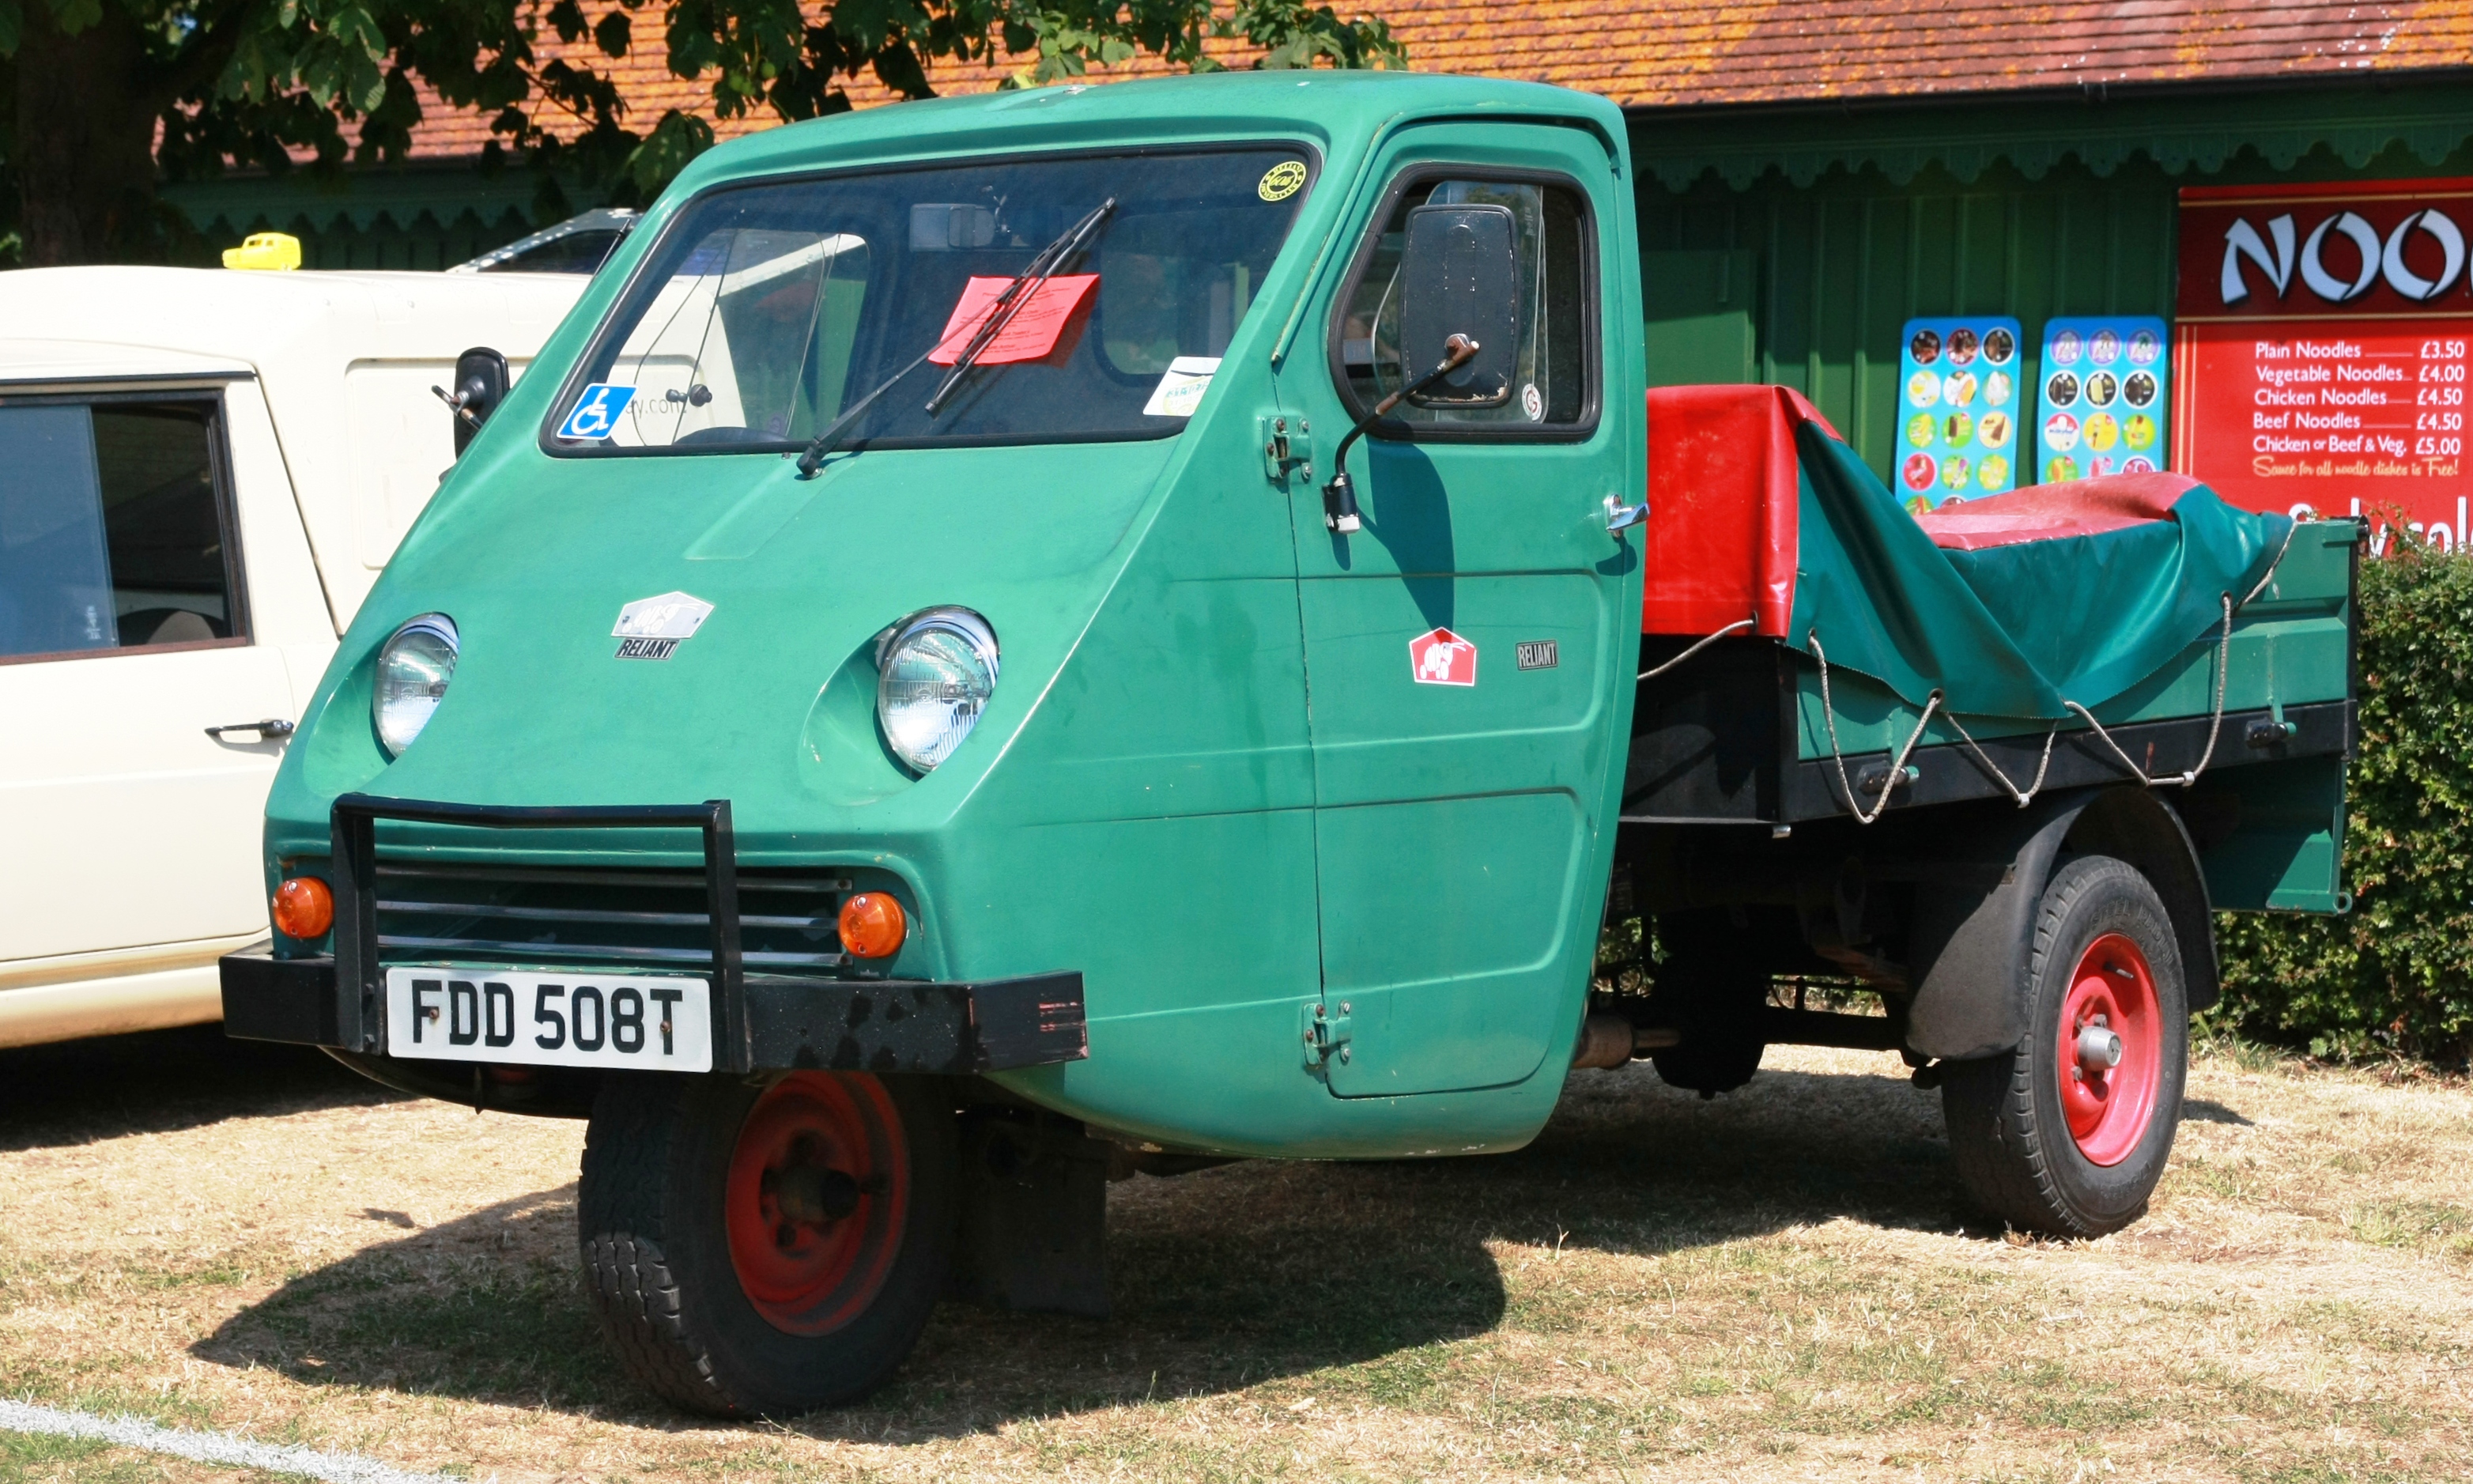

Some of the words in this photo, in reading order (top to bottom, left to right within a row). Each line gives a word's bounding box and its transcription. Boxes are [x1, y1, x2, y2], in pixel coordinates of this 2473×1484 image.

[2220, 208, 2473, 304] NOO
[2256, 342, 2290, 358] Plain
[2296, 341, 2361, 358] Noodles
[2421, 341, 2465, 358] £3.50
[2256, 365, 2331, 387] Vegetable
[2337, 364, 2403, 381] Noodles
[2419, 364, 2465, 382] £4.00
[2254, 388, 2315, 406] Chicken
[2321, 388, 2387, 405] Noodles
[2417, 387, 2463, 406] £4.50
[2253, 412, 2290, 429] Beef
[2296, 412, 2361, 429] Noodles
[2417, 412, 2462, 430] £4.50
[2253, 435, 2310, 452] Chicken
[2313, 439, 2327, 450] or
[2328, 435, 2364, 452] Beef
[2365, 438, 2376, 453] &
[2377, 434, 2407, 458] Veg.
[2415, 436, 2461, 455] £5.00
[2252, 455, 2297, 478] Sauce
[2298, 460, 2314, 477] for
[2316, 460, 2332, 476] all
[2335, 460, 2371, 477] noodle
[2373, 460, 2408, 477] dishes
[2411, 463, 2421, 477] is
[2421, 457, 2458, 478] Free!
[617, 639, 676, 659] RELIANT
[1517, 643, 1557, 668] RELIANT
[411, 979, 515, 1048] FDD
[534, 984, 683, 1055] 508T
